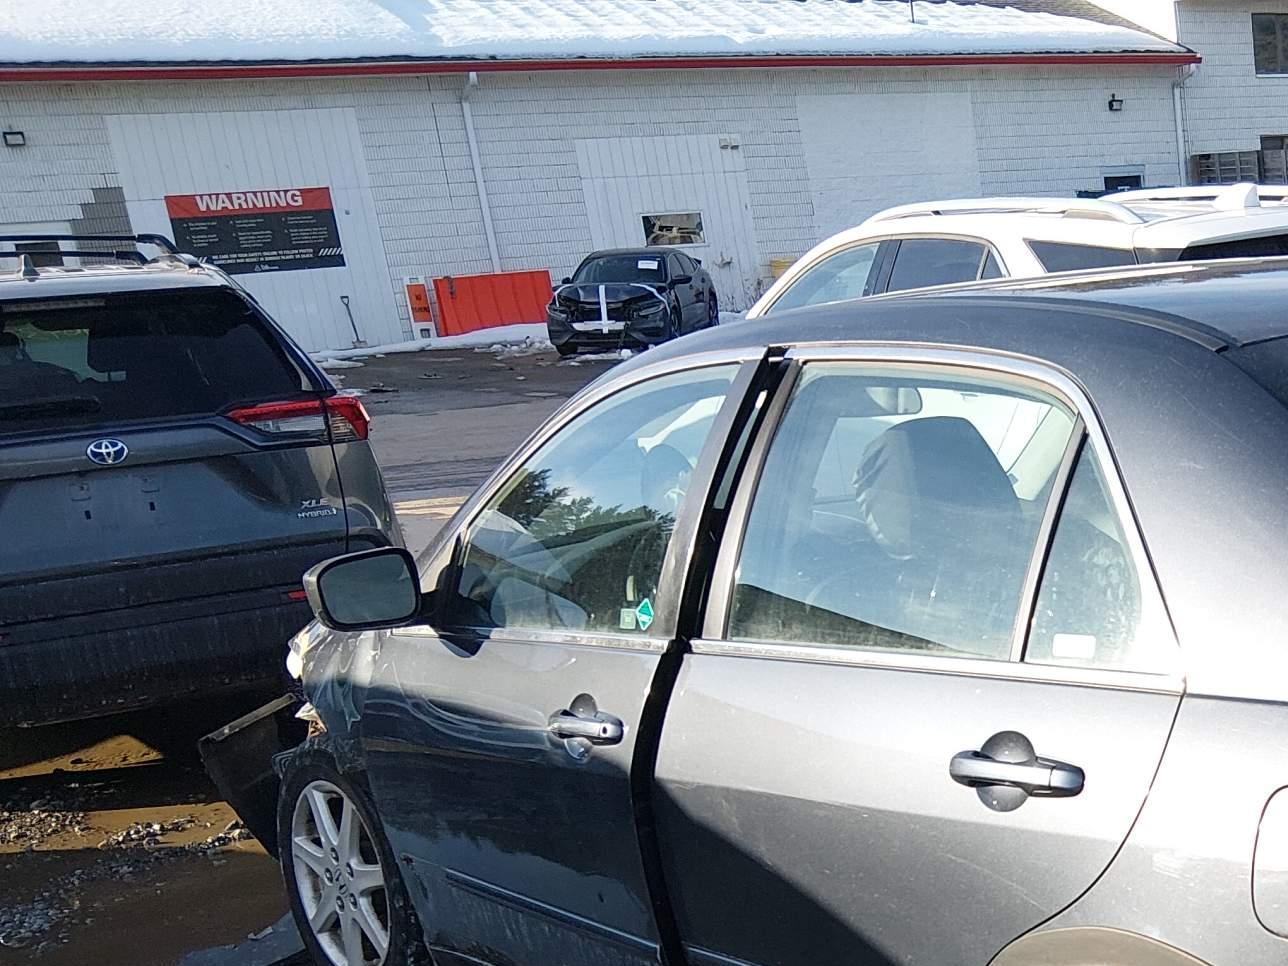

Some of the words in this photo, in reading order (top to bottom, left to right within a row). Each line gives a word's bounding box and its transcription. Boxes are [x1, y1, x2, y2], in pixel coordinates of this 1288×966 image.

[195, 190, 303, 212] WARNING
[301, 497, 329, 508] XLE
[297, 509, 332, 519] HYBRID
